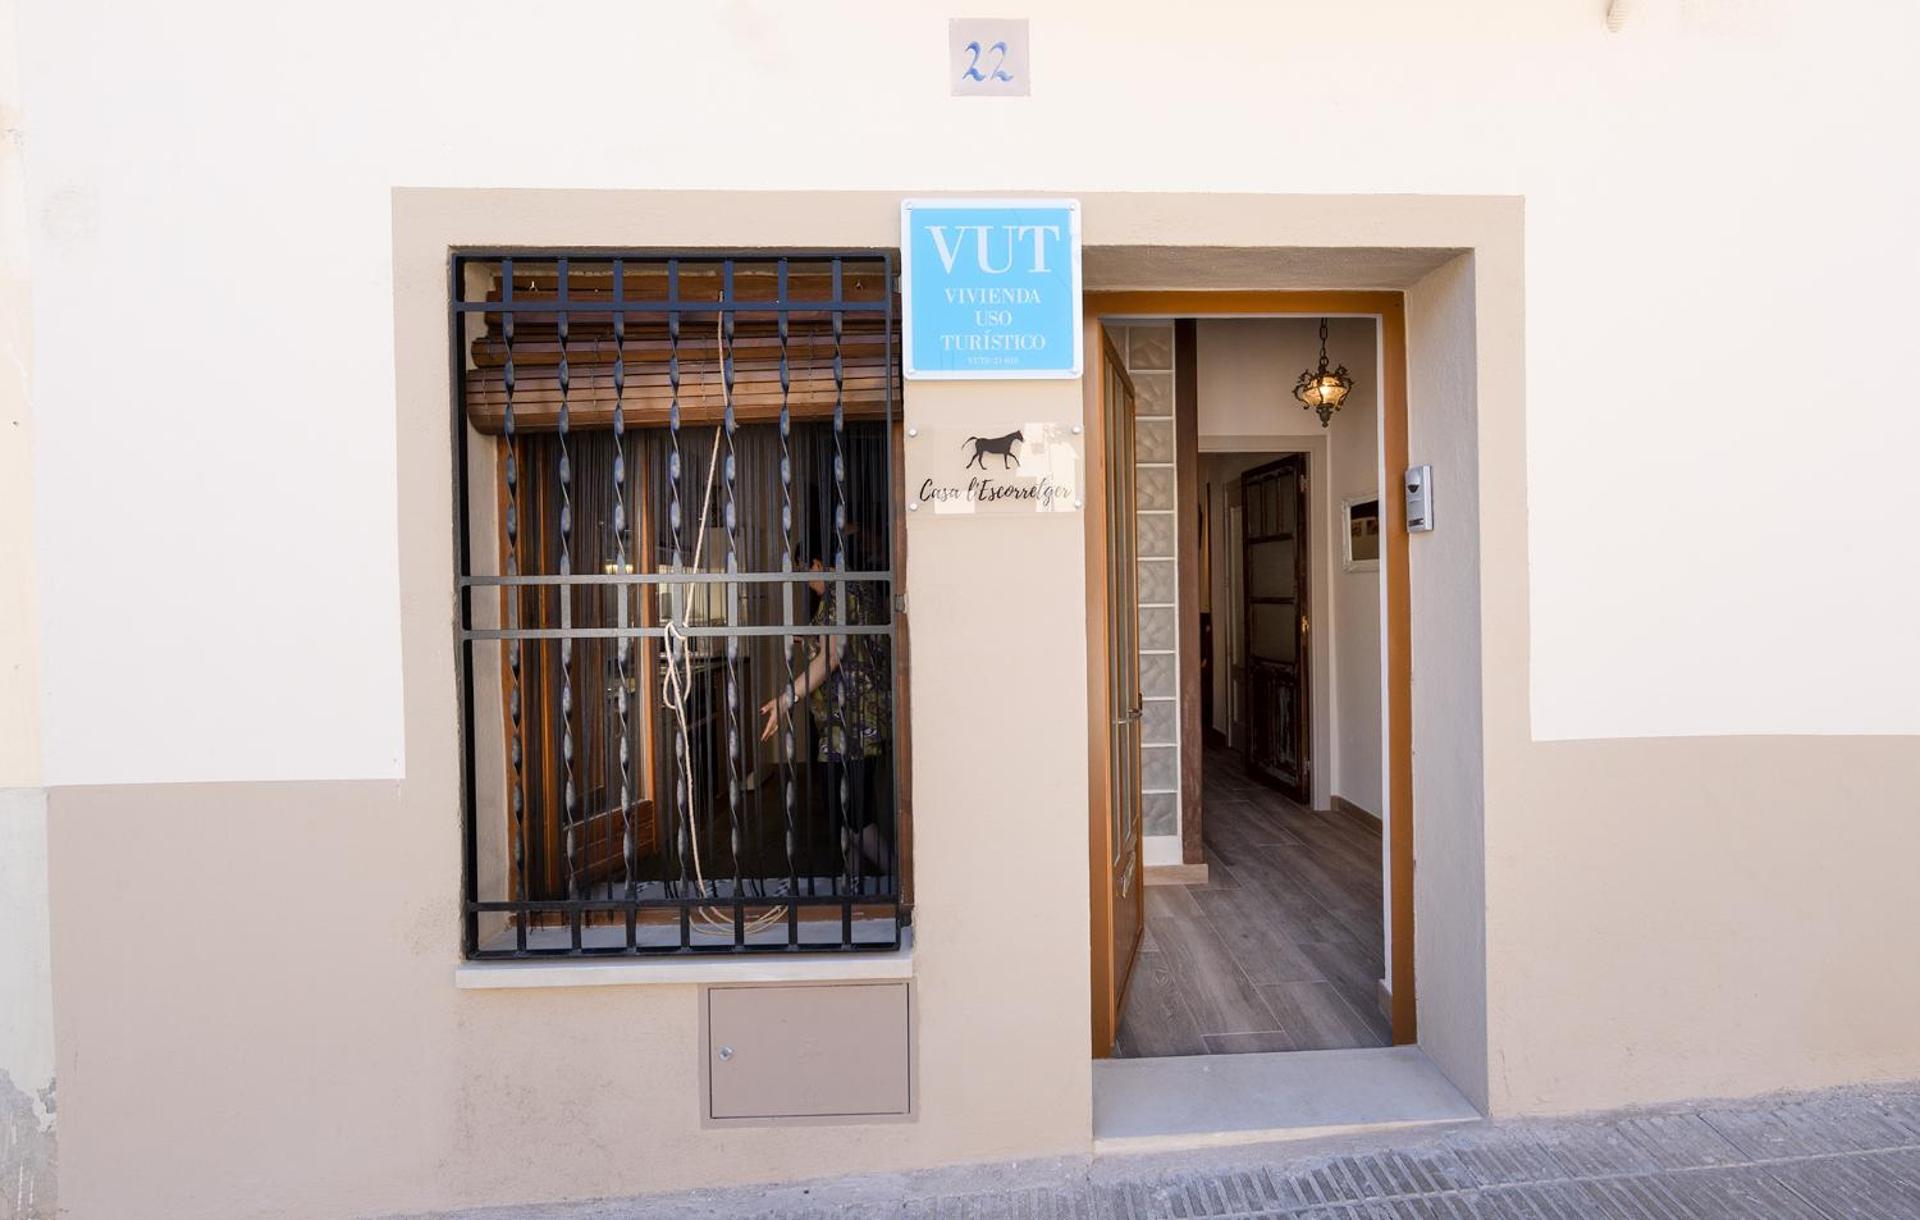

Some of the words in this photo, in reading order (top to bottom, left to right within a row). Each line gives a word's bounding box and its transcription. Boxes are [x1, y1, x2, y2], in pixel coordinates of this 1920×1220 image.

[962, 41, 1014, 82] 22
[925, 225, 1060, 274] VUT
[945, 288, 1041, 304] VIVIENDA
[975, 310, 1012, 327] USO
[941, 330, 1046, 351] TURÍSTICO
[919, 478, 960, 502] Casa
